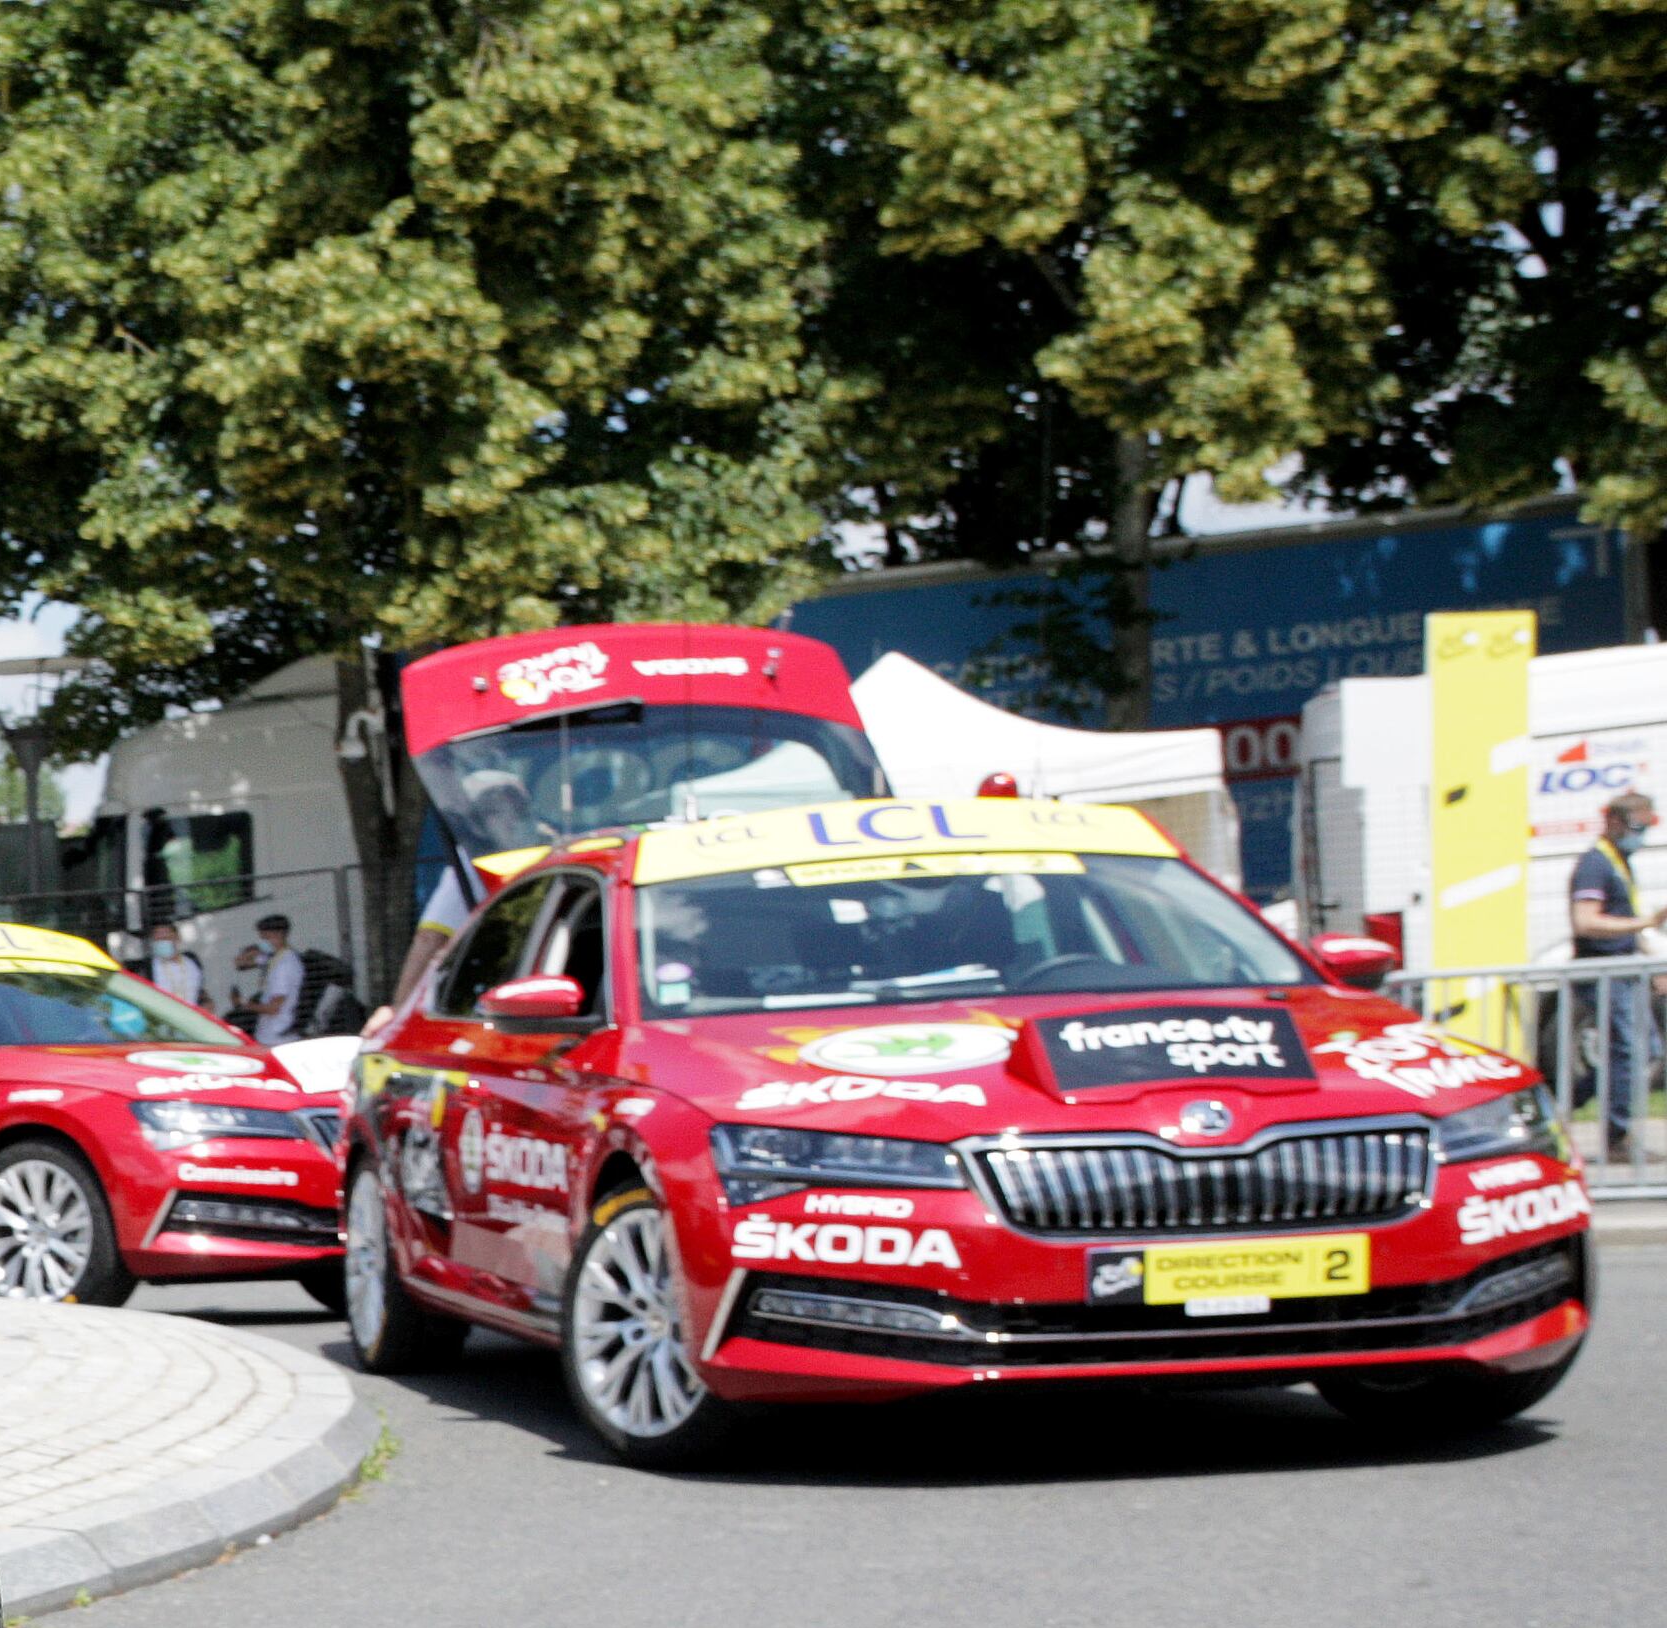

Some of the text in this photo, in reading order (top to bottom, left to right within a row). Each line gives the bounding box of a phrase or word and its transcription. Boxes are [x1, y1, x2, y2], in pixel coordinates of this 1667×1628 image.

[806, 804, 988, 846] LCL
[1166, 1040, 1286, 1074] sport
[1456, 1179, 1592, 1246] ŠKODA
[730, 1212, 962, 1269] ŠKODA
[1155, 1249, 1351, 1282] DIRECTION 2
[1173, 1271, 1284, 1292] COURSE
